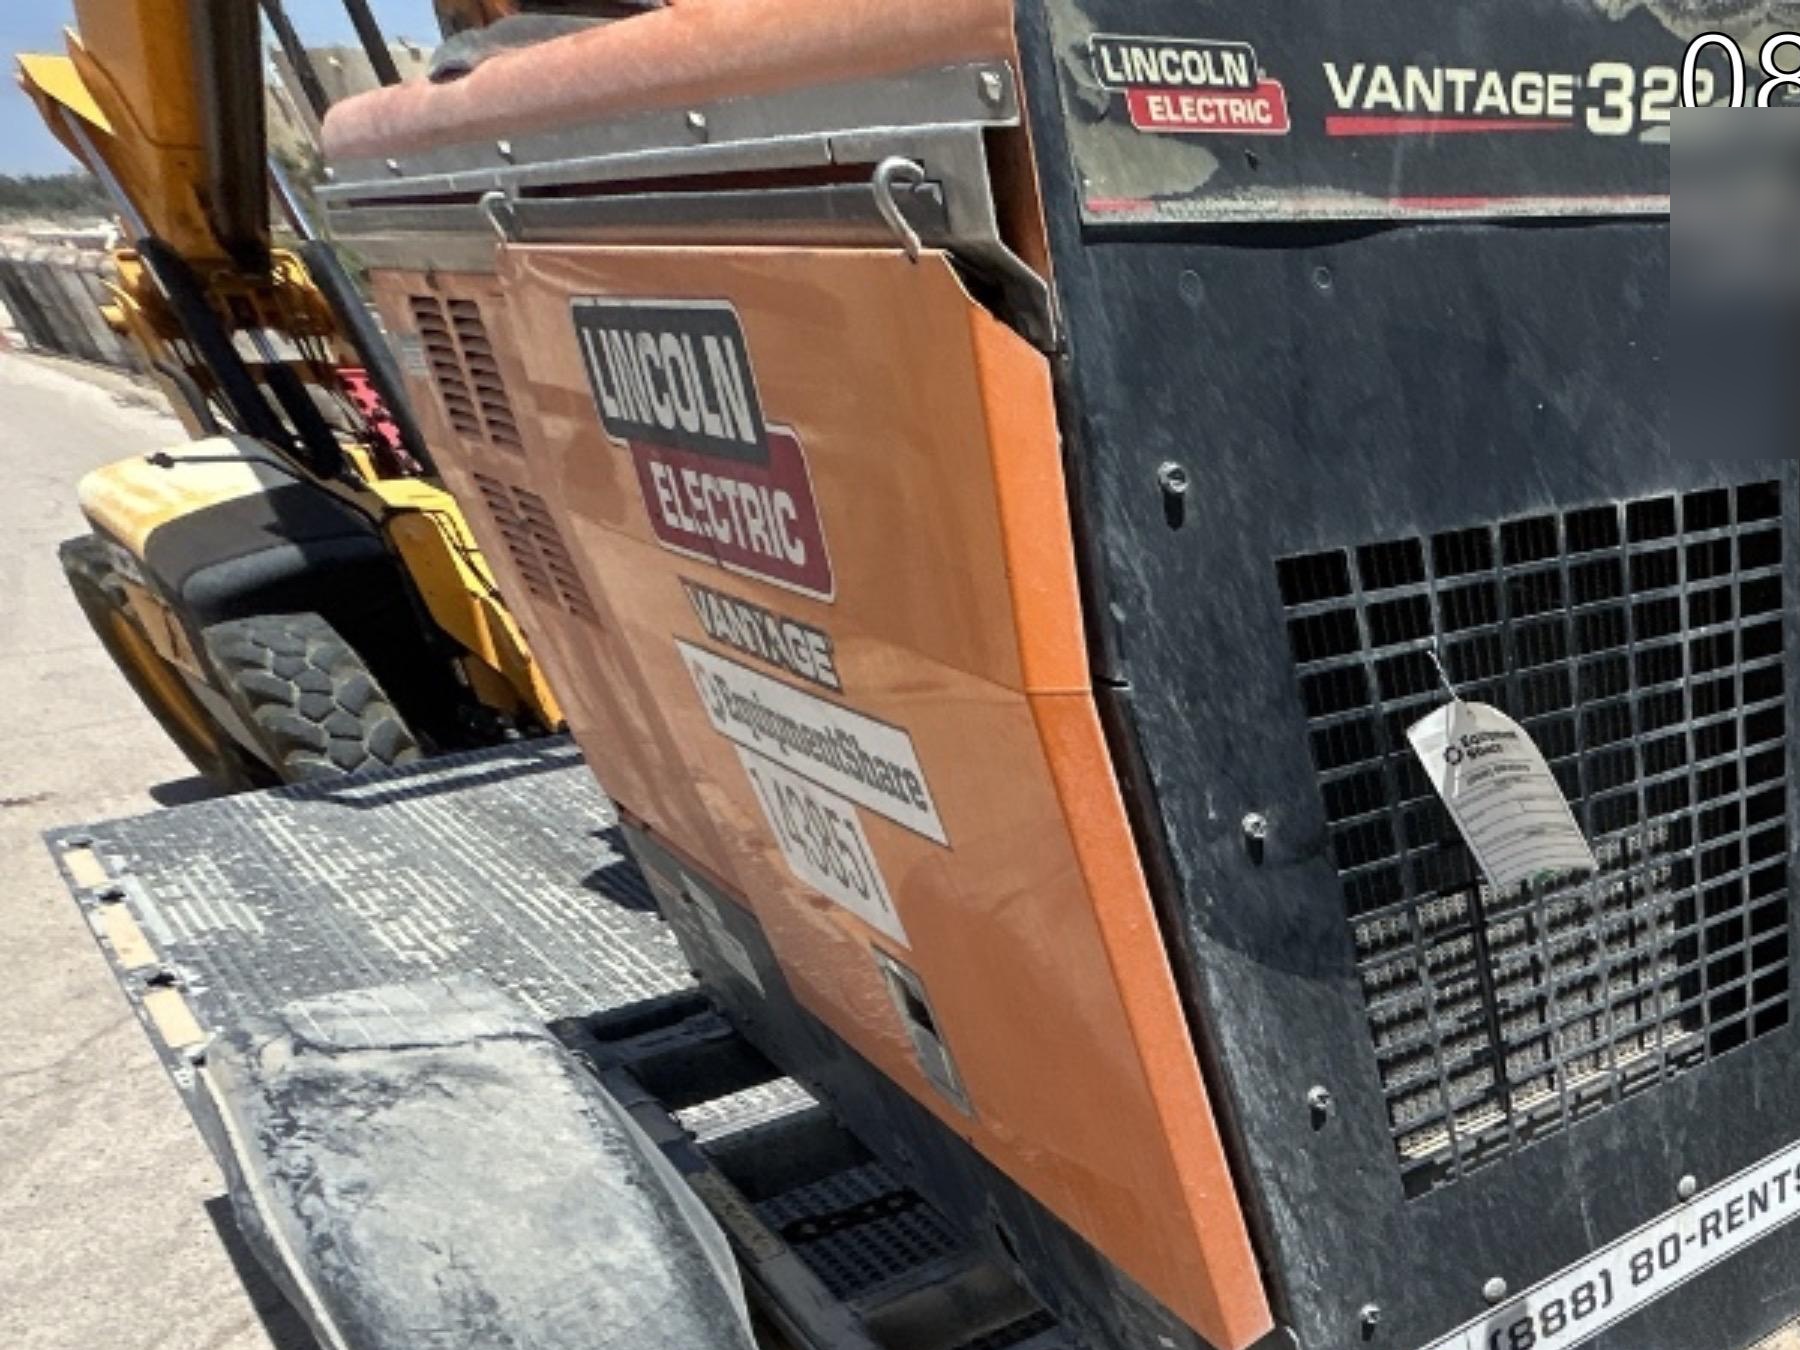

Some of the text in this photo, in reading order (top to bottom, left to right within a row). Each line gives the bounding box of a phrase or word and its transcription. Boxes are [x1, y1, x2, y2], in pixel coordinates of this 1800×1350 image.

[1100, 44, 1250, 88] LINCOLN
[1321, 61, 1574, 117] VANTAGE
[1145, 95, 1273, 124] ELECTRIC
[582, 328, 758, 445] LINCOLN
[649, 460, 806, 567] ELECTRIC
[686, 582, 840, 689] VANTAGE
